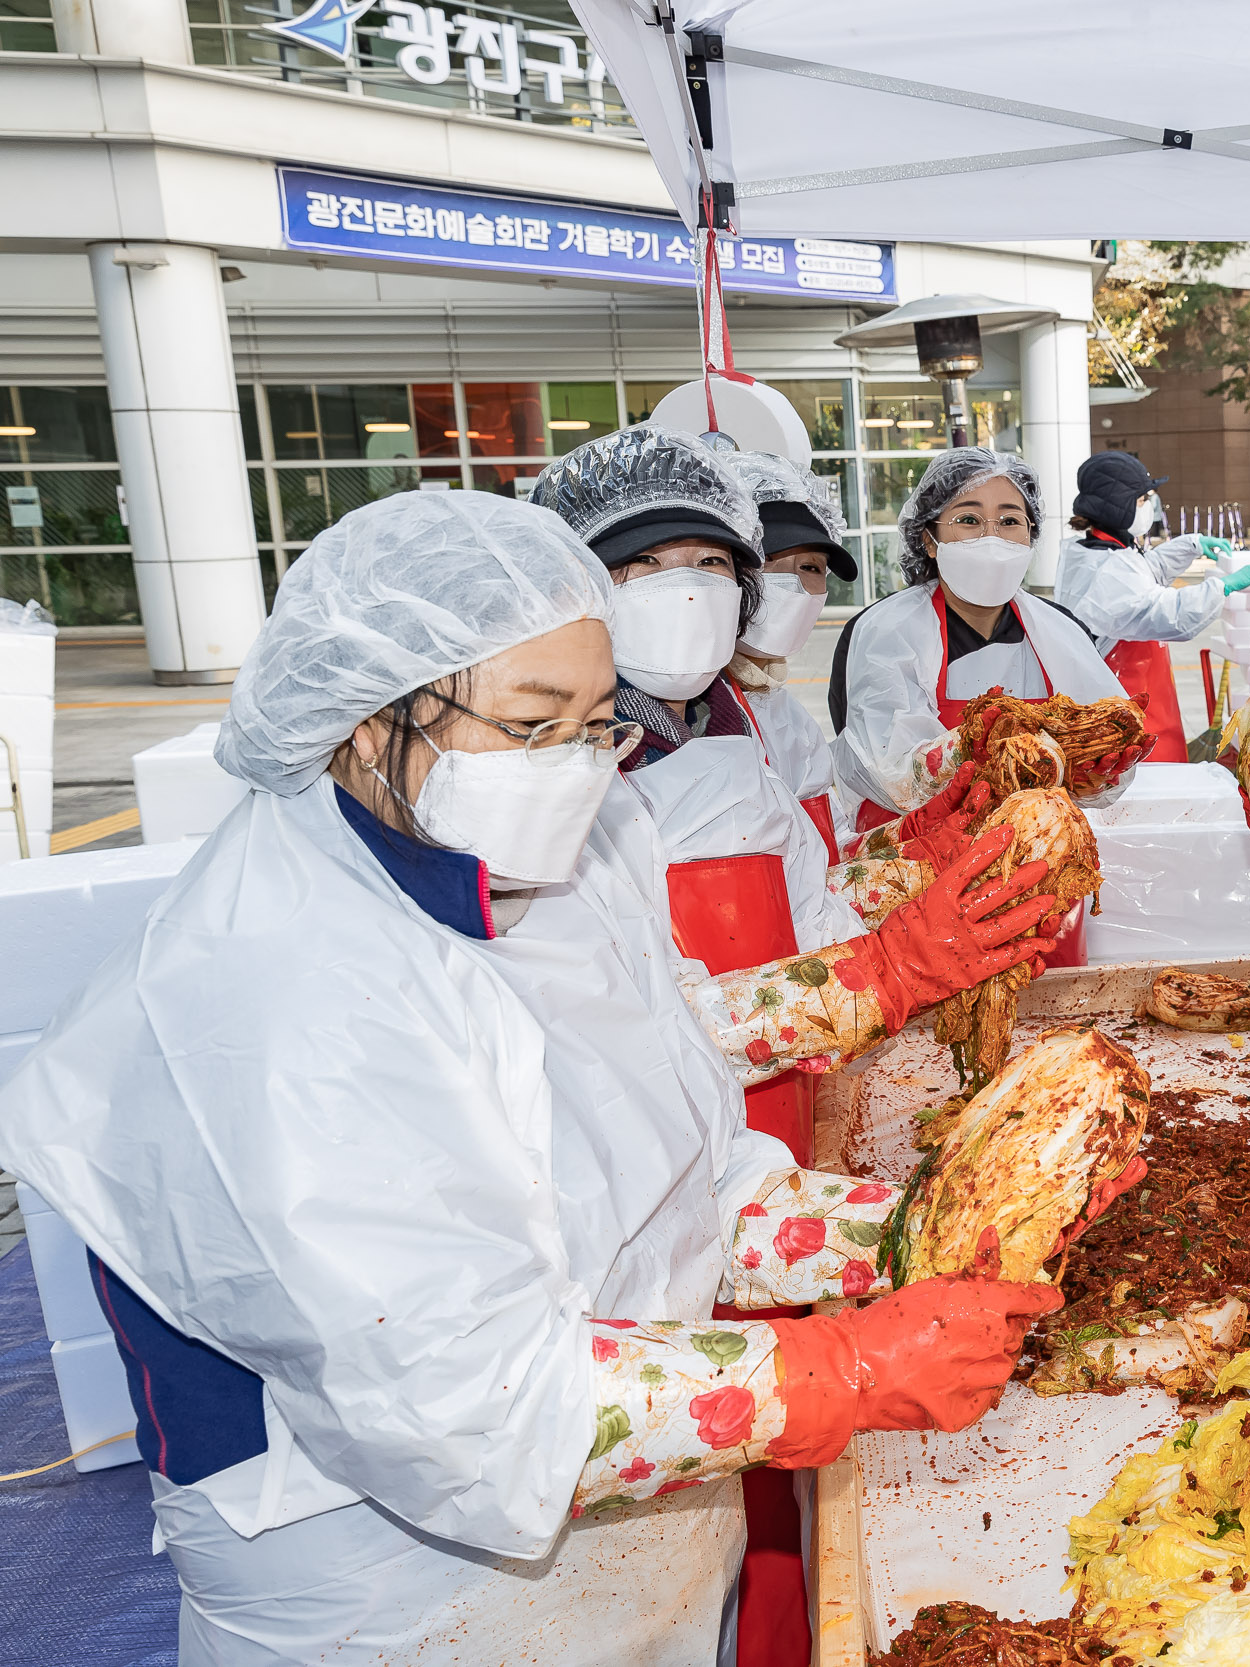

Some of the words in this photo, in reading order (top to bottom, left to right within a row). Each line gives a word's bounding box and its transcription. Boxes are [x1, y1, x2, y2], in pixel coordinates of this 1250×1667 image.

[381, 0, 607, 104] 광진구
[306, 190, 551, 251] 광진문화예술회관
[557, 221, 660, 262] 겨울학기
[665, 235, 737, 270] 수생
[741, 242, 786, 275] 모집
